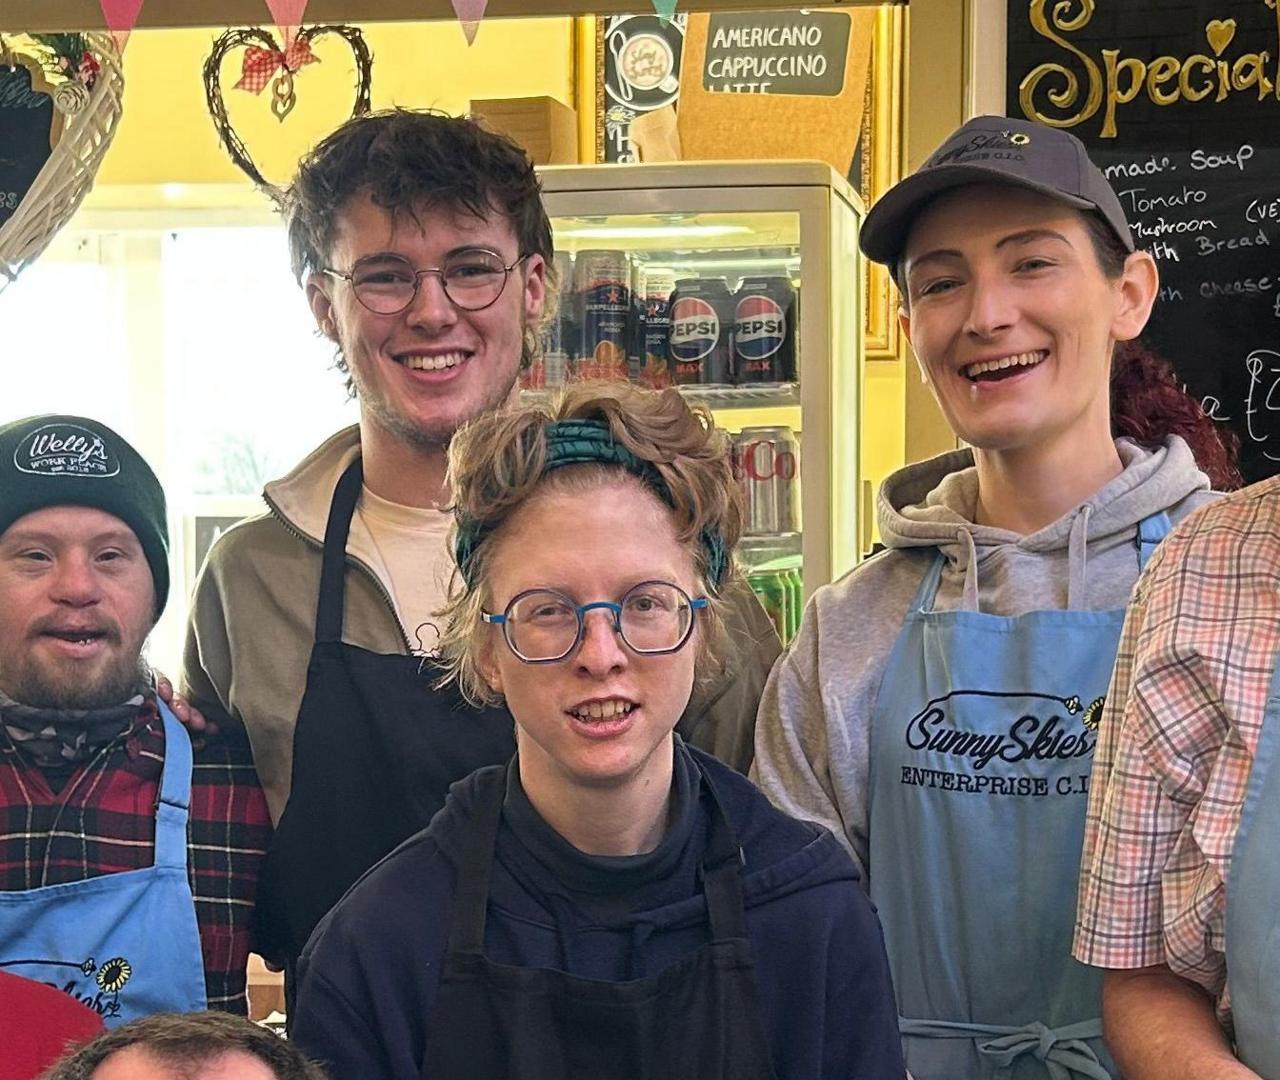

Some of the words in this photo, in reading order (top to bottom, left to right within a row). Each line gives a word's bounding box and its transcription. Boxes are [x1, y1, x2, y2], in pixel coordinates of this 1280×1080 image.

[712, 26, 822, 48] AMERICANO
[708, 54, 827, 78] CAPPUCCINO
[1191, 145, 1254, 171] Soup
[1119, 186, 1207, 214] Tomato
[1128, 217, 1218, 239] Mushroom
[1195, 230, 1271, 256] Bread
[30, 457, 66, 470] WORK
[906, 707, 1092, 770] SunnySkies
[901, 766, 1049, 797] ENTERPRISE
